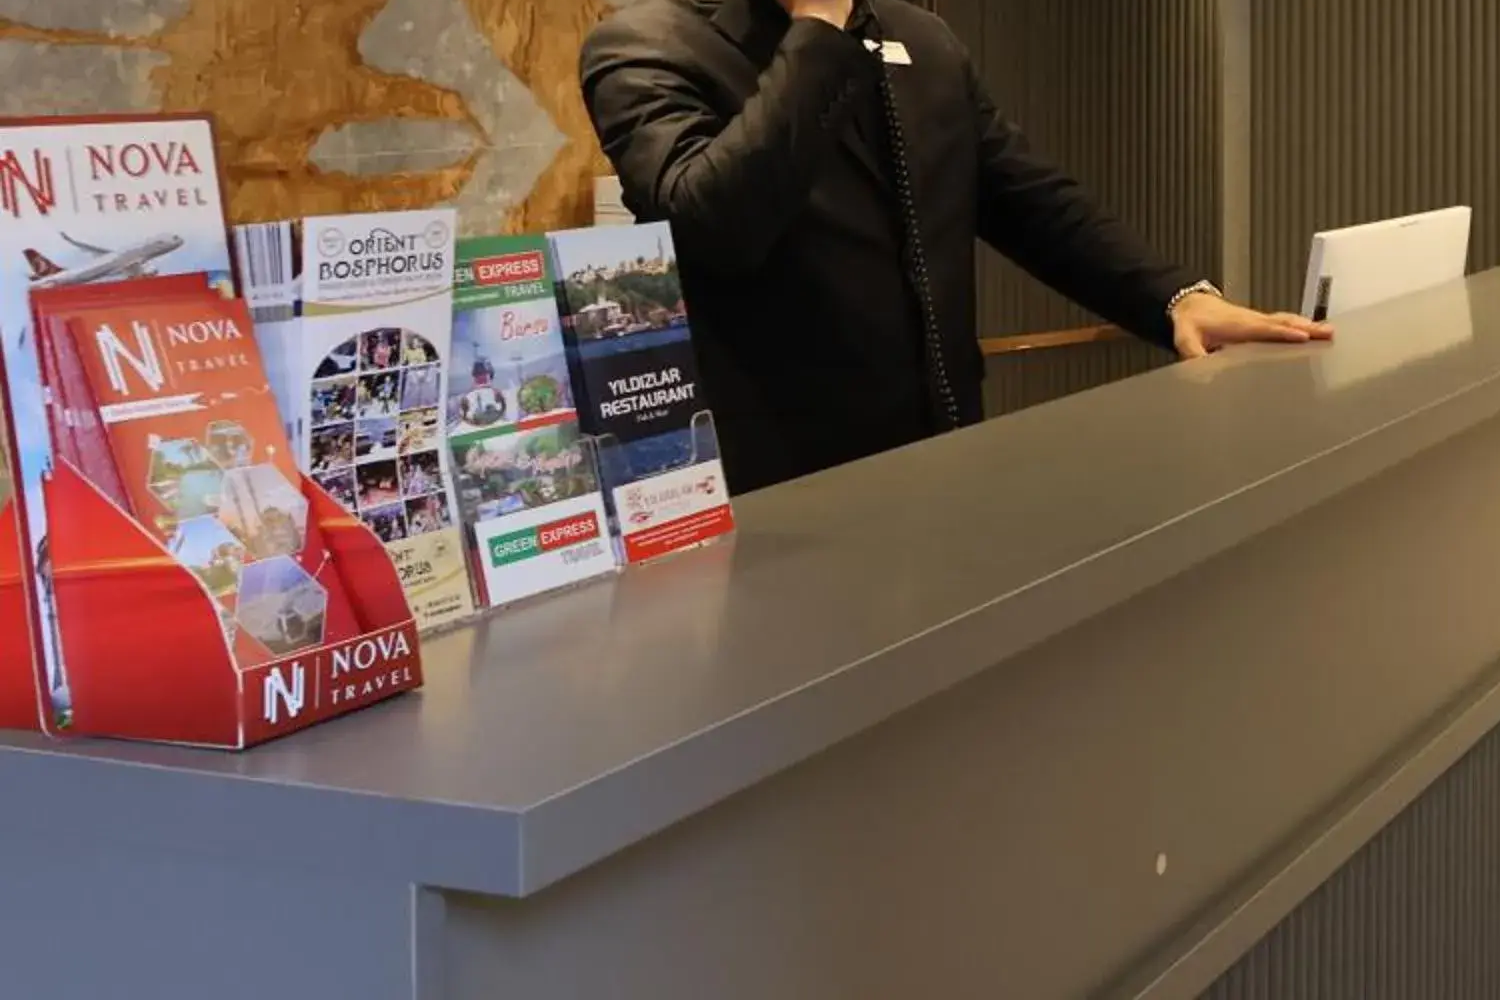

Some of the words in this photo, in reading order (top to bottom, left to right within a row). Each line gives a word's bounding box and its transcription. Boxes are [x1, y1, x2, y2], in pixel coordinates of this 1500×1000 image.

[88, 142, 202, 181] NOVA
[93, 188, 208, 213] TRAVEL
[348, 232, 417, 255] ORIENT
[319, 252, 444, 281] BOSPHORUS
[478, 258, 540, 280] EXPRESS
[504, 282, 546, 299] TRAVEL
[166, 319, 242, 347] NOVA
[176, 352, 250, 377] TRAVEL
[607, 367, 682, 397] YILDIZLAR
[600, 383, 696, 419] RESTAURANT
[493, 536, 538, 558] GREEN
[540, 519, 597, 545] EXPRESS
[330, 630, 412, 679] NOVA
[330, 668, 414, 705] TRAVEL
